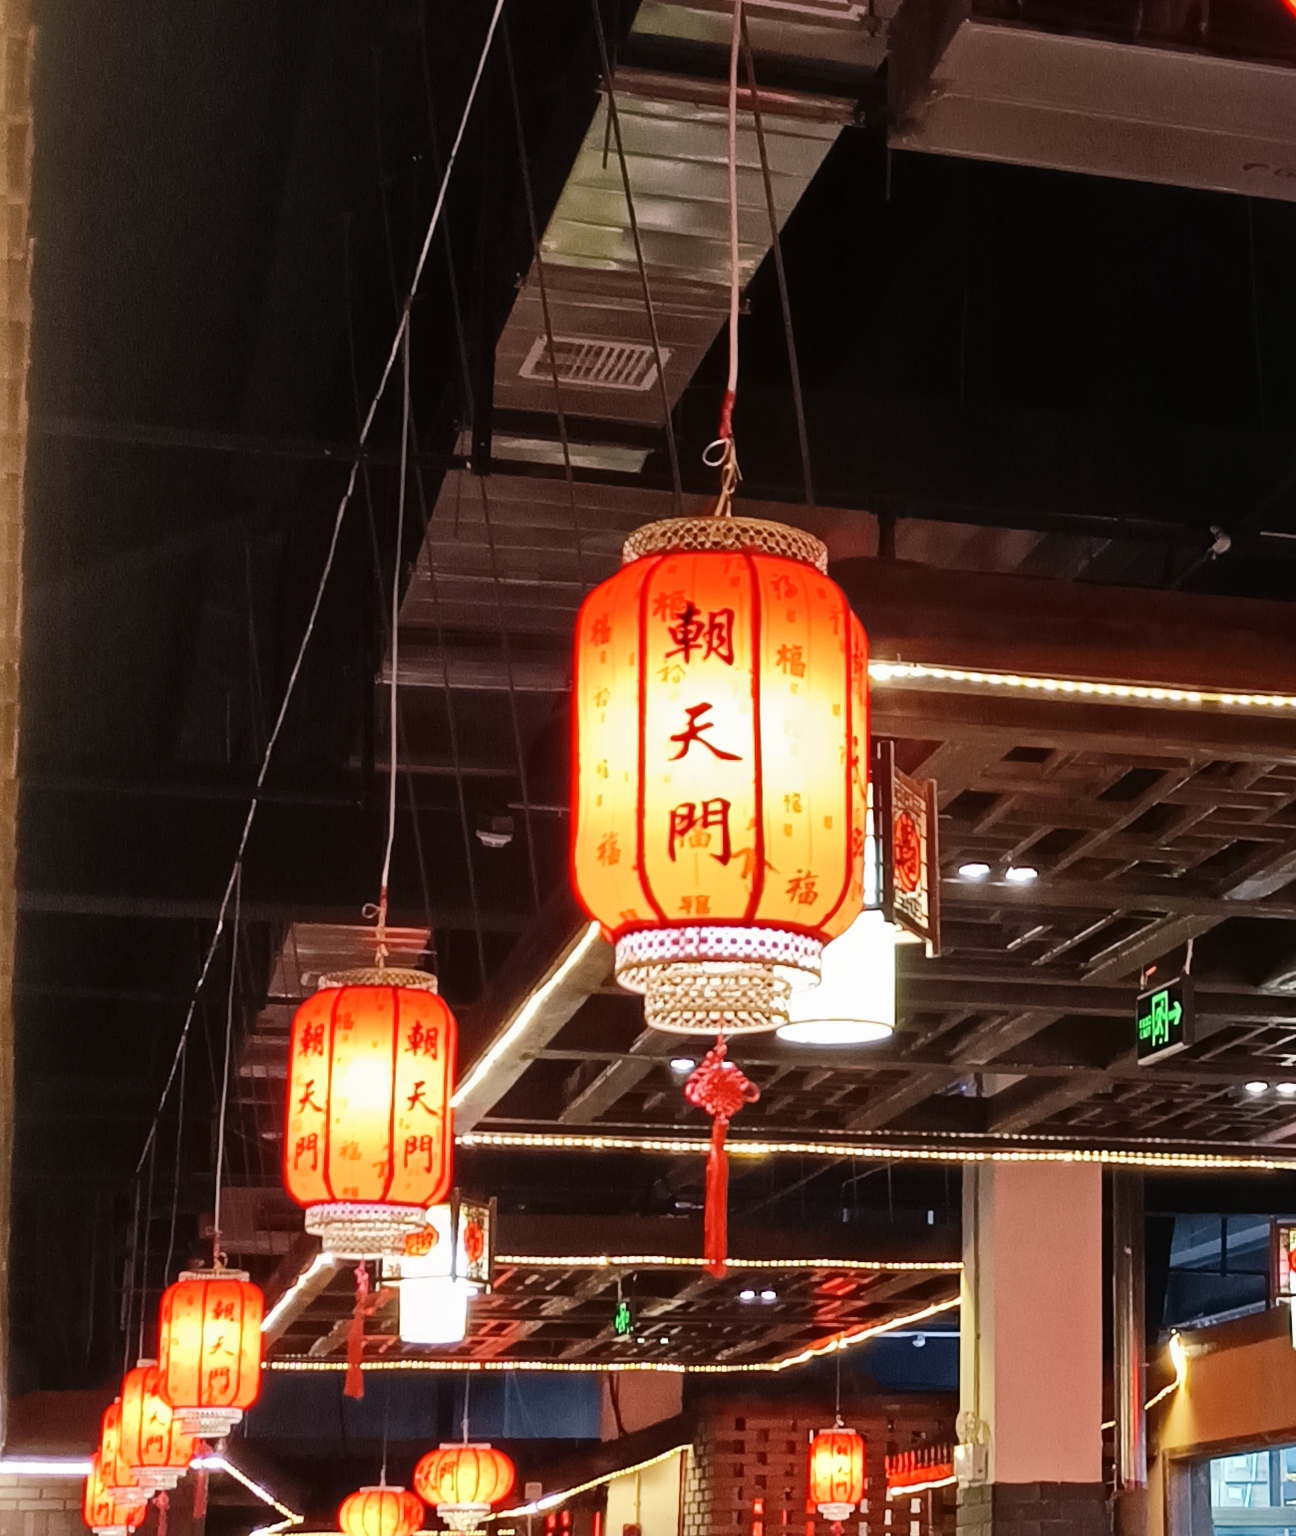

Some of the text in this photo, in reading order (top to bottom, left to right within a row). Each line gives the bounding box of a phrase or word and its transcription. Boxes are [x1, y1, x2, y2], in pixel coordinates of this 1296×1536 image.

[664, 600, 743, 866] 朝天門
[293, 1021, 327, 1173] 朝天門
[403, 1019, 441, 1175] 朝天門
[208, 1299, 236, 1404] 朝天門
